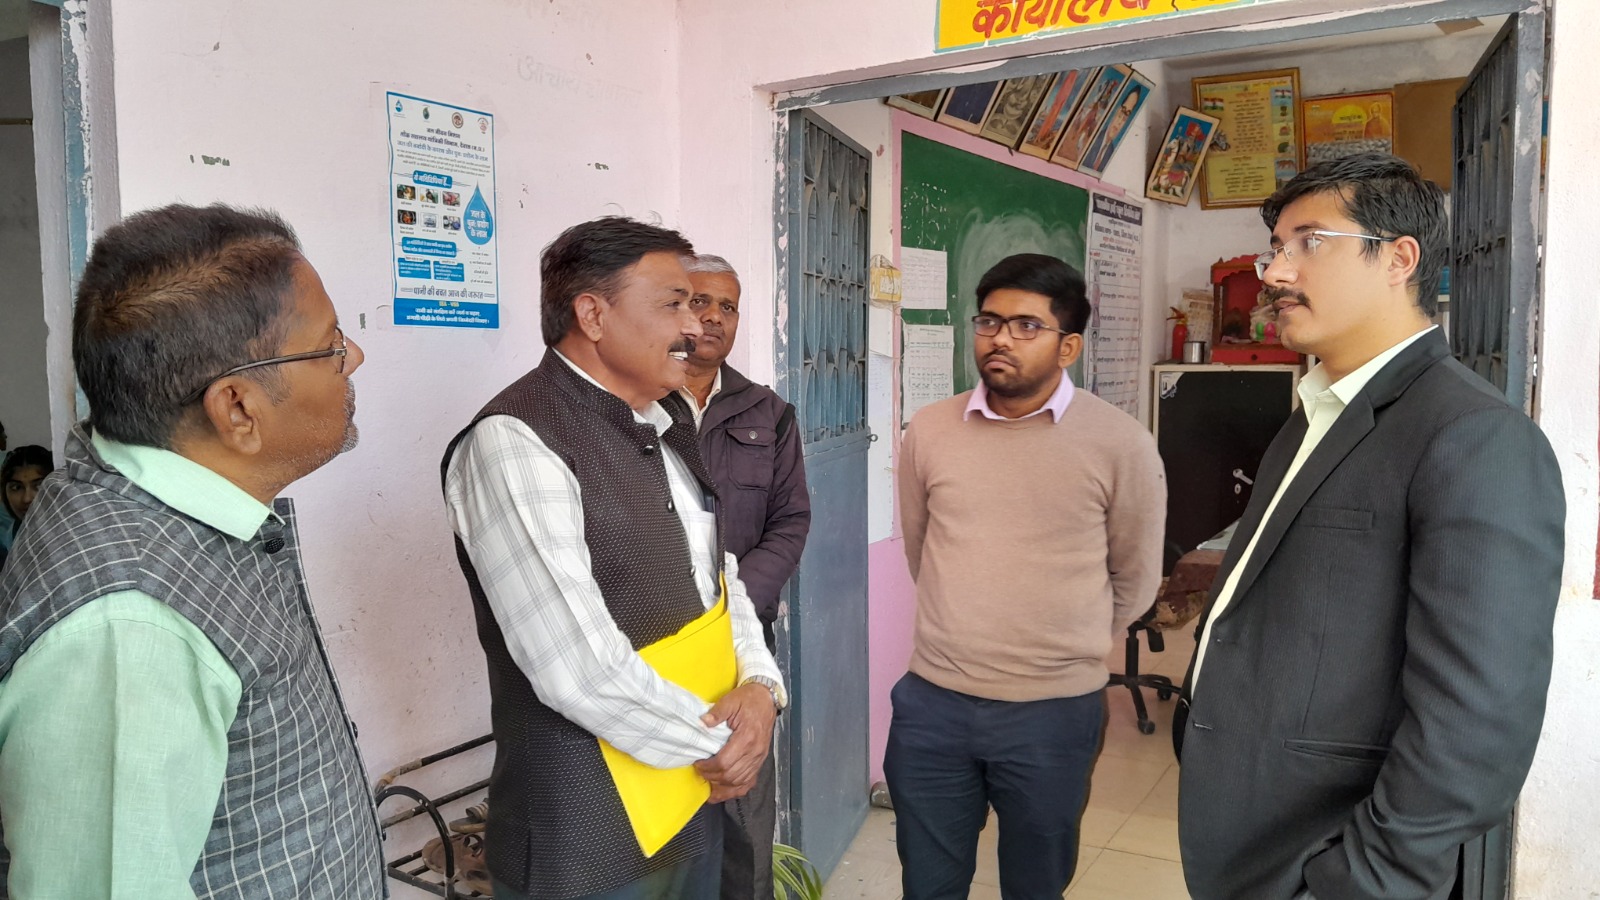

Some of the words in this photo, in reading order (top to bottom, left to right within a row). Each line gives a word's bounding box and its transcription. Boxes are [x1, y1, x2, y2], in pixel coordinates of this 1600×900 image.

[414, 284, 427, 295] पानी
[427, 285, 435, 296] की
[436, 288, 447, 296] बचत
[448, 290, 460, 298] आज
[460, 288, 468, 298] की
